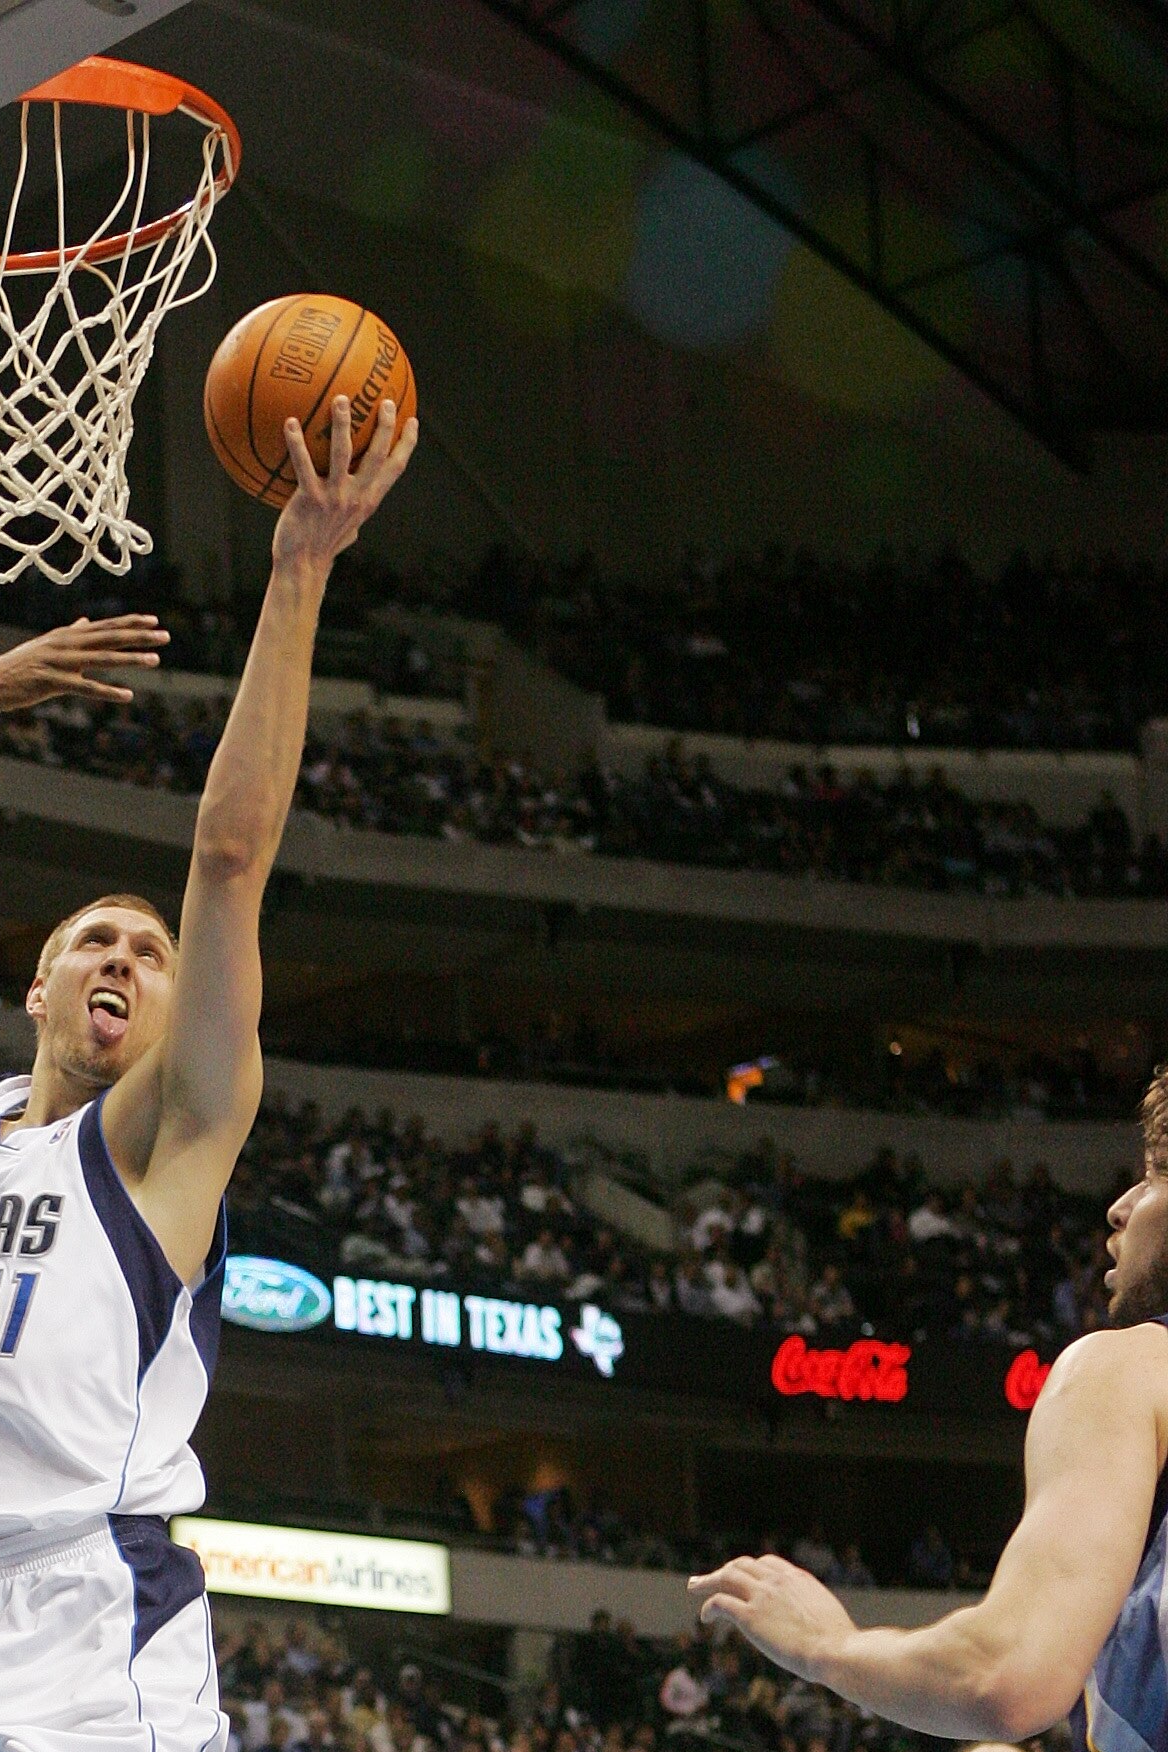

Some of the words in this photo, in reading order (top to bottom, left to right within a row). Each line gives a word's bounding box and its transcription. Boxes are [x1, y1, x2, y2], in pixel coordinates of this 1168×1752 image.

[333, 1276, 417, 1340] BEST
[420, 1288, 462, 1347] IN
[464, 1294, 564, 1362] TEXAS
